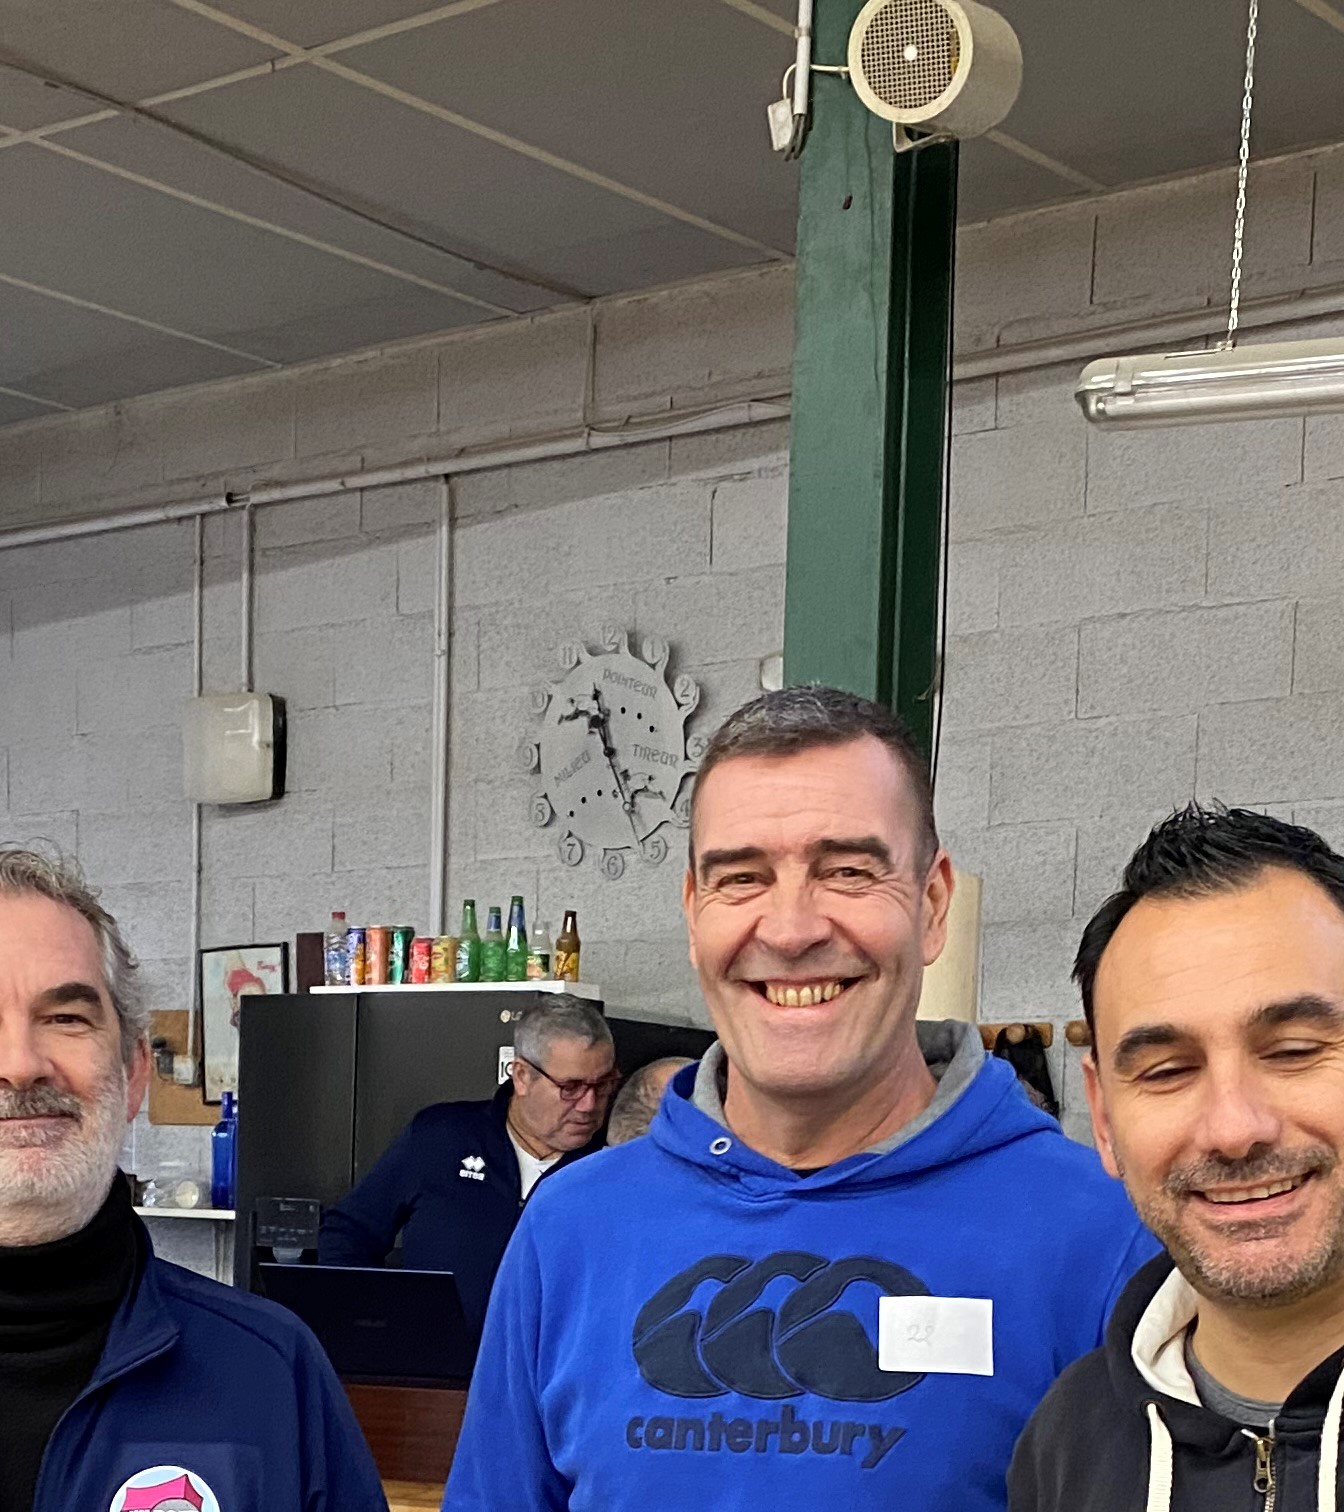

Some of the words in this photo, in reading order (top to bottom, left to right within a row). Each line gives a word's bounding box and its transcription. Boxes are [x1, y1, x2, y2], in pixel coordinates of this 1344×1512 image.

[679, 676, 692, 699] 2
[566, 843, 577, 860] 7
[650, 841, 661, 860] 5
[607, 855, 619, 876] 6
[626, 1405, 907, 1469] canterbury
